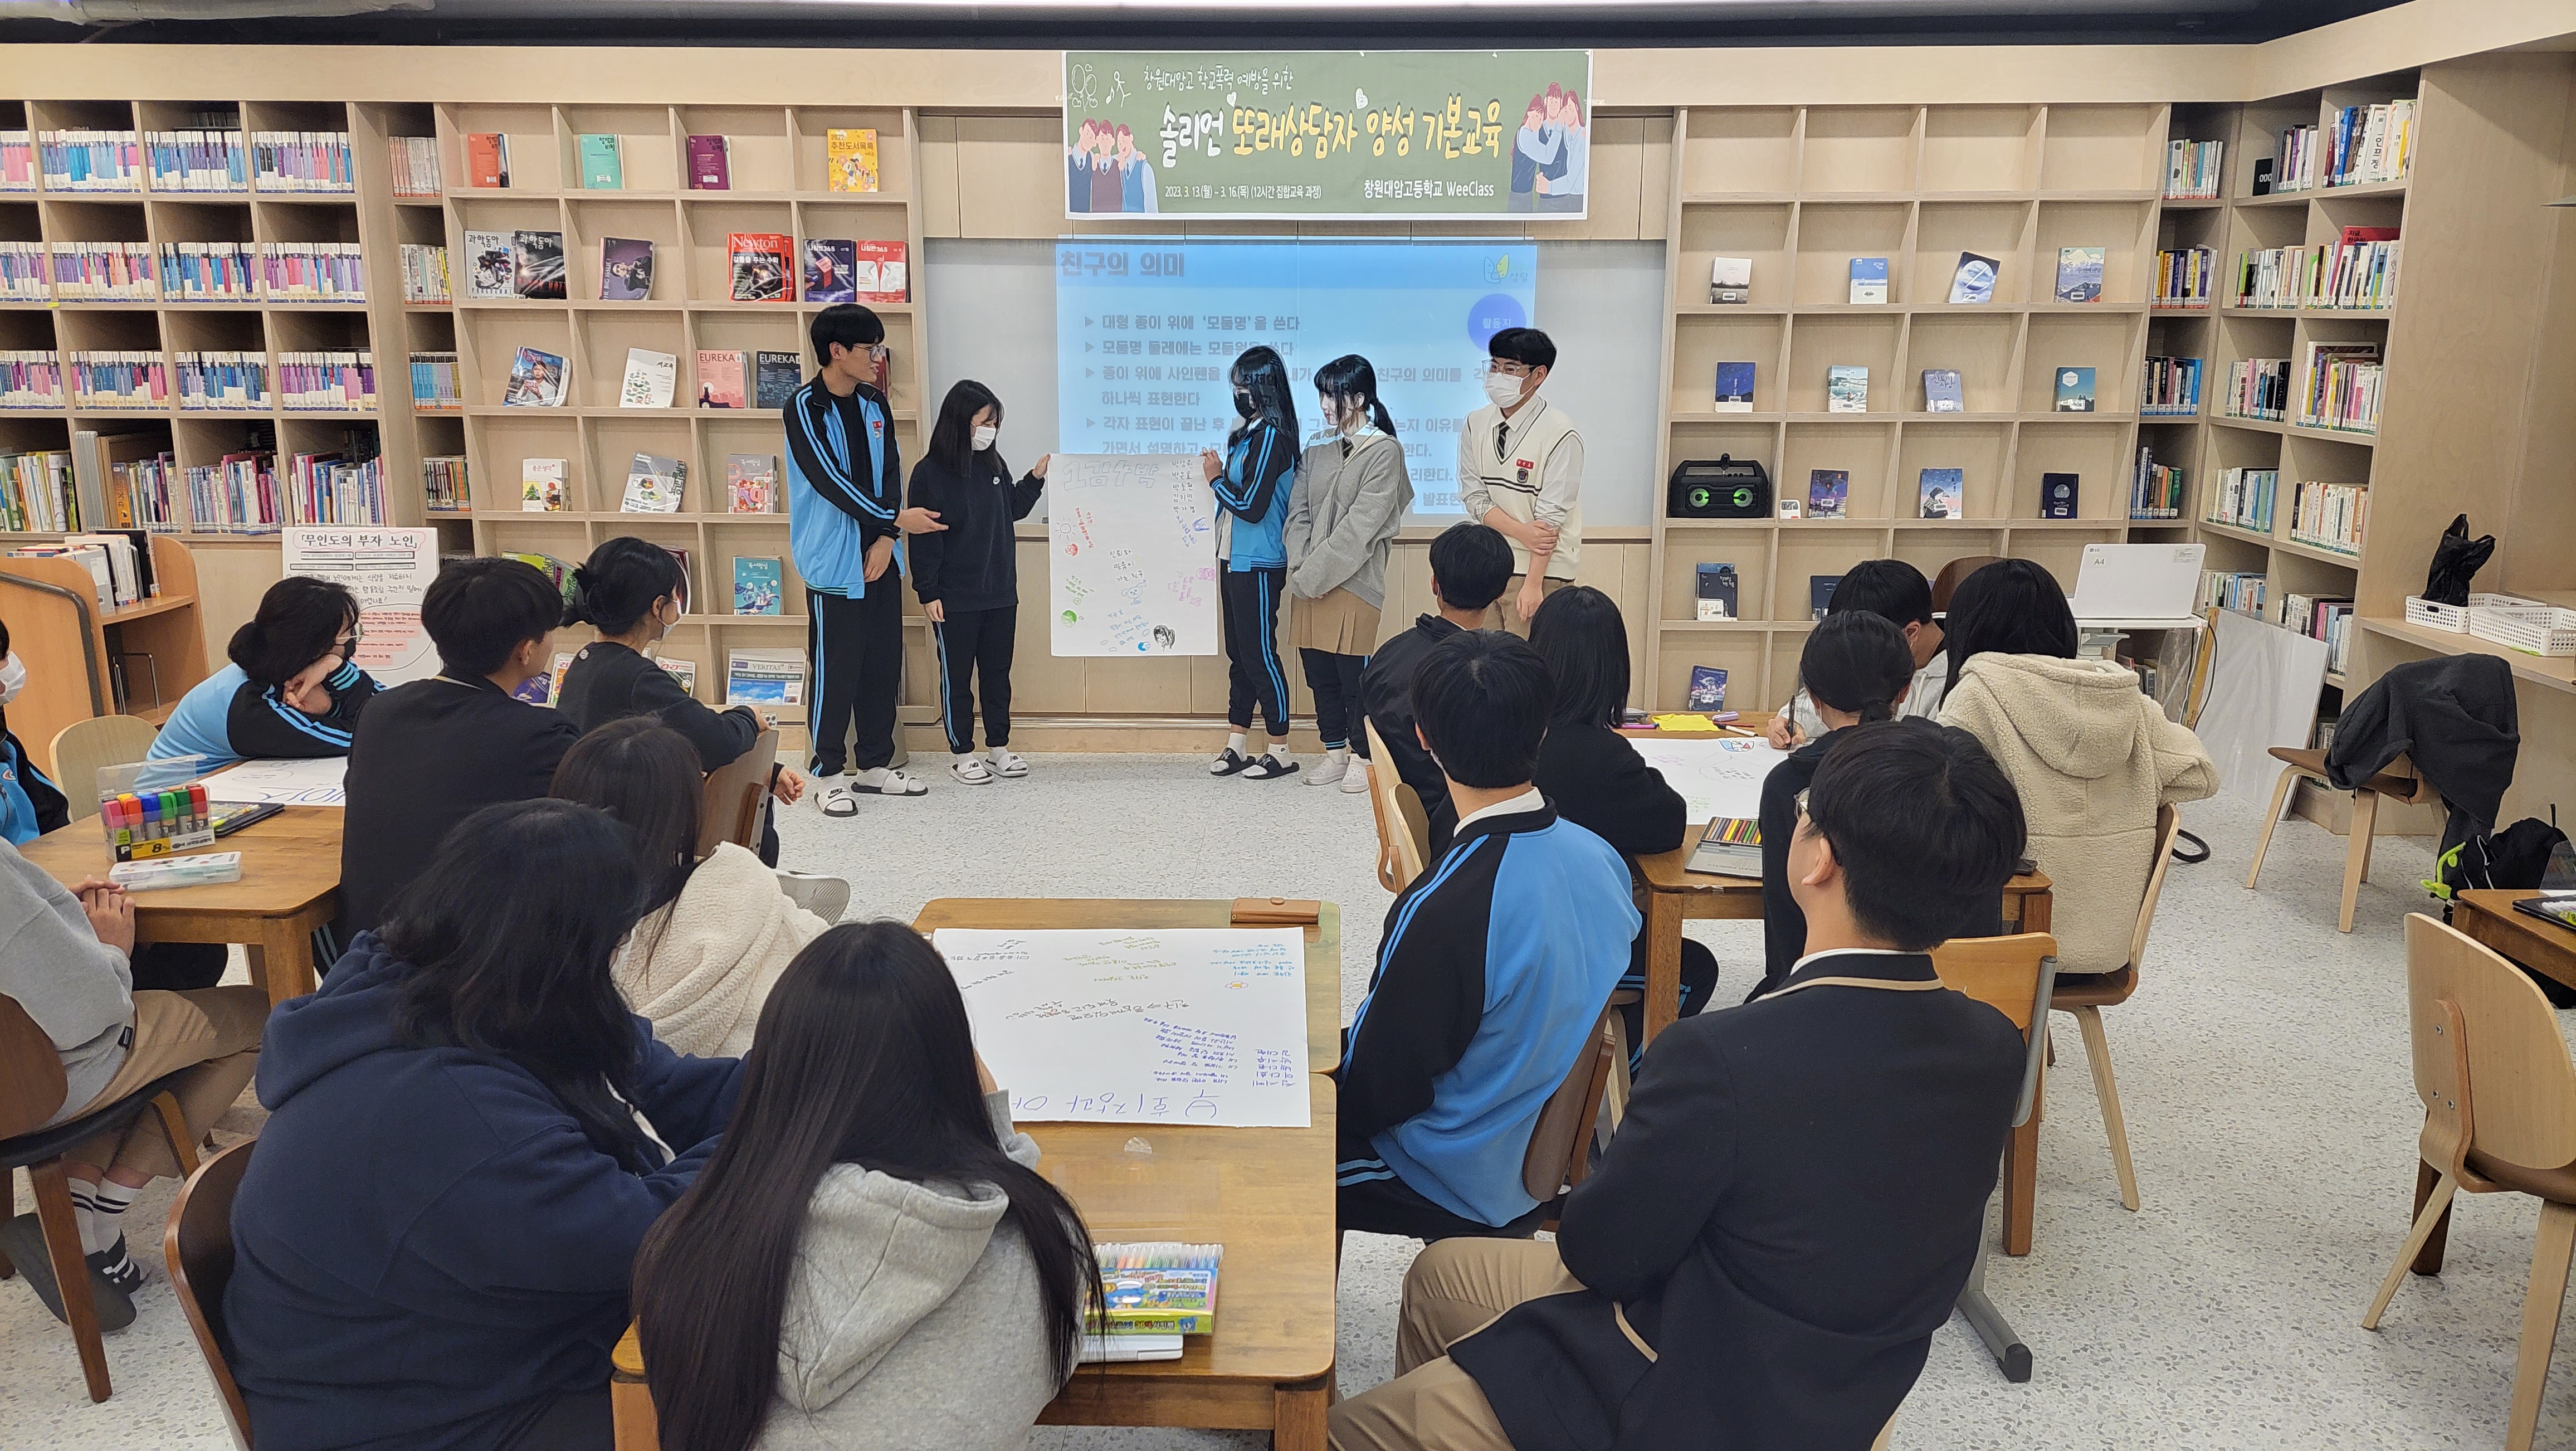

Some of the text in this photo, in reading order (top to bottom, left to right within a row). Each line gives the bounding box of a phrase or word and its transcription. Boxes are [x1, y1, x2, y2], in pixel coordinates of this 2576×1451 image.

[1144, 64, 1294, 95] 창원대암고 학교폭력 예방을 위한
[1160, 92, 1502, 168] 솔리언 또래상담자 양성 기본교육
[831, 142, 873, 150] 추천도서목록
[1165, 185, 1182, 198] 2023.
[1184, 185, 1189, 198] 3.
[1192, 184, 1212, 199] 13.(월)
[1221, 185, 1226, 198] 3.
[1229, 184, 1248, 199] 16.(목)
[1251, 184, 1275, 199] (12시간
[1276, 184, 1304, 199] 집합교육
[1305, 184, 1321, 199] 과정)
[1364, 179, 1494, 198] 창원대암고등학교 WeeClass
[468, 234, 499, 248] 과학동아
[519, 233, 553, 250] 과학동아
[733, 235, 778, 249] Newton
[1060, 251, 1184, 277] 친구의 의미
[1102, 315, 1129, 329] 대형
[1135, 315, 1160, 329] 종이
[1168, 315, 1194, 330] 위에
[1273, 316, 1300, 330] 쓴다
[1482, 318, 1511, 329] 활동지
[1102, 340, 1141, 355] 모둠명
[1148, 340, 1202, 356] 둘레에는
[700, 353, 735, 363] EUREKA
[759, 353, 796, 364] EUREKA
[1103, 366, 1129, 381] 종이
[1135, 366, 1162, 381] 위에
[1168, 366, 1221, 381] 사인펜을
[1378, 367, 1416, 382] 친구의
[1422, 367, 1462, 382] 의미를
[1102, 391, 1200, 406] 하나씩 표현한다
[1103, 416, 1129, 431] 각자
[1136, 416, 1174, 431] 표현이
[1180, 417, 1207, 431] 끝난
[1212, 417, 1225, 431] 후
[358, 534, 383, 547] 부자
[152, 843, 162, 853] 8
